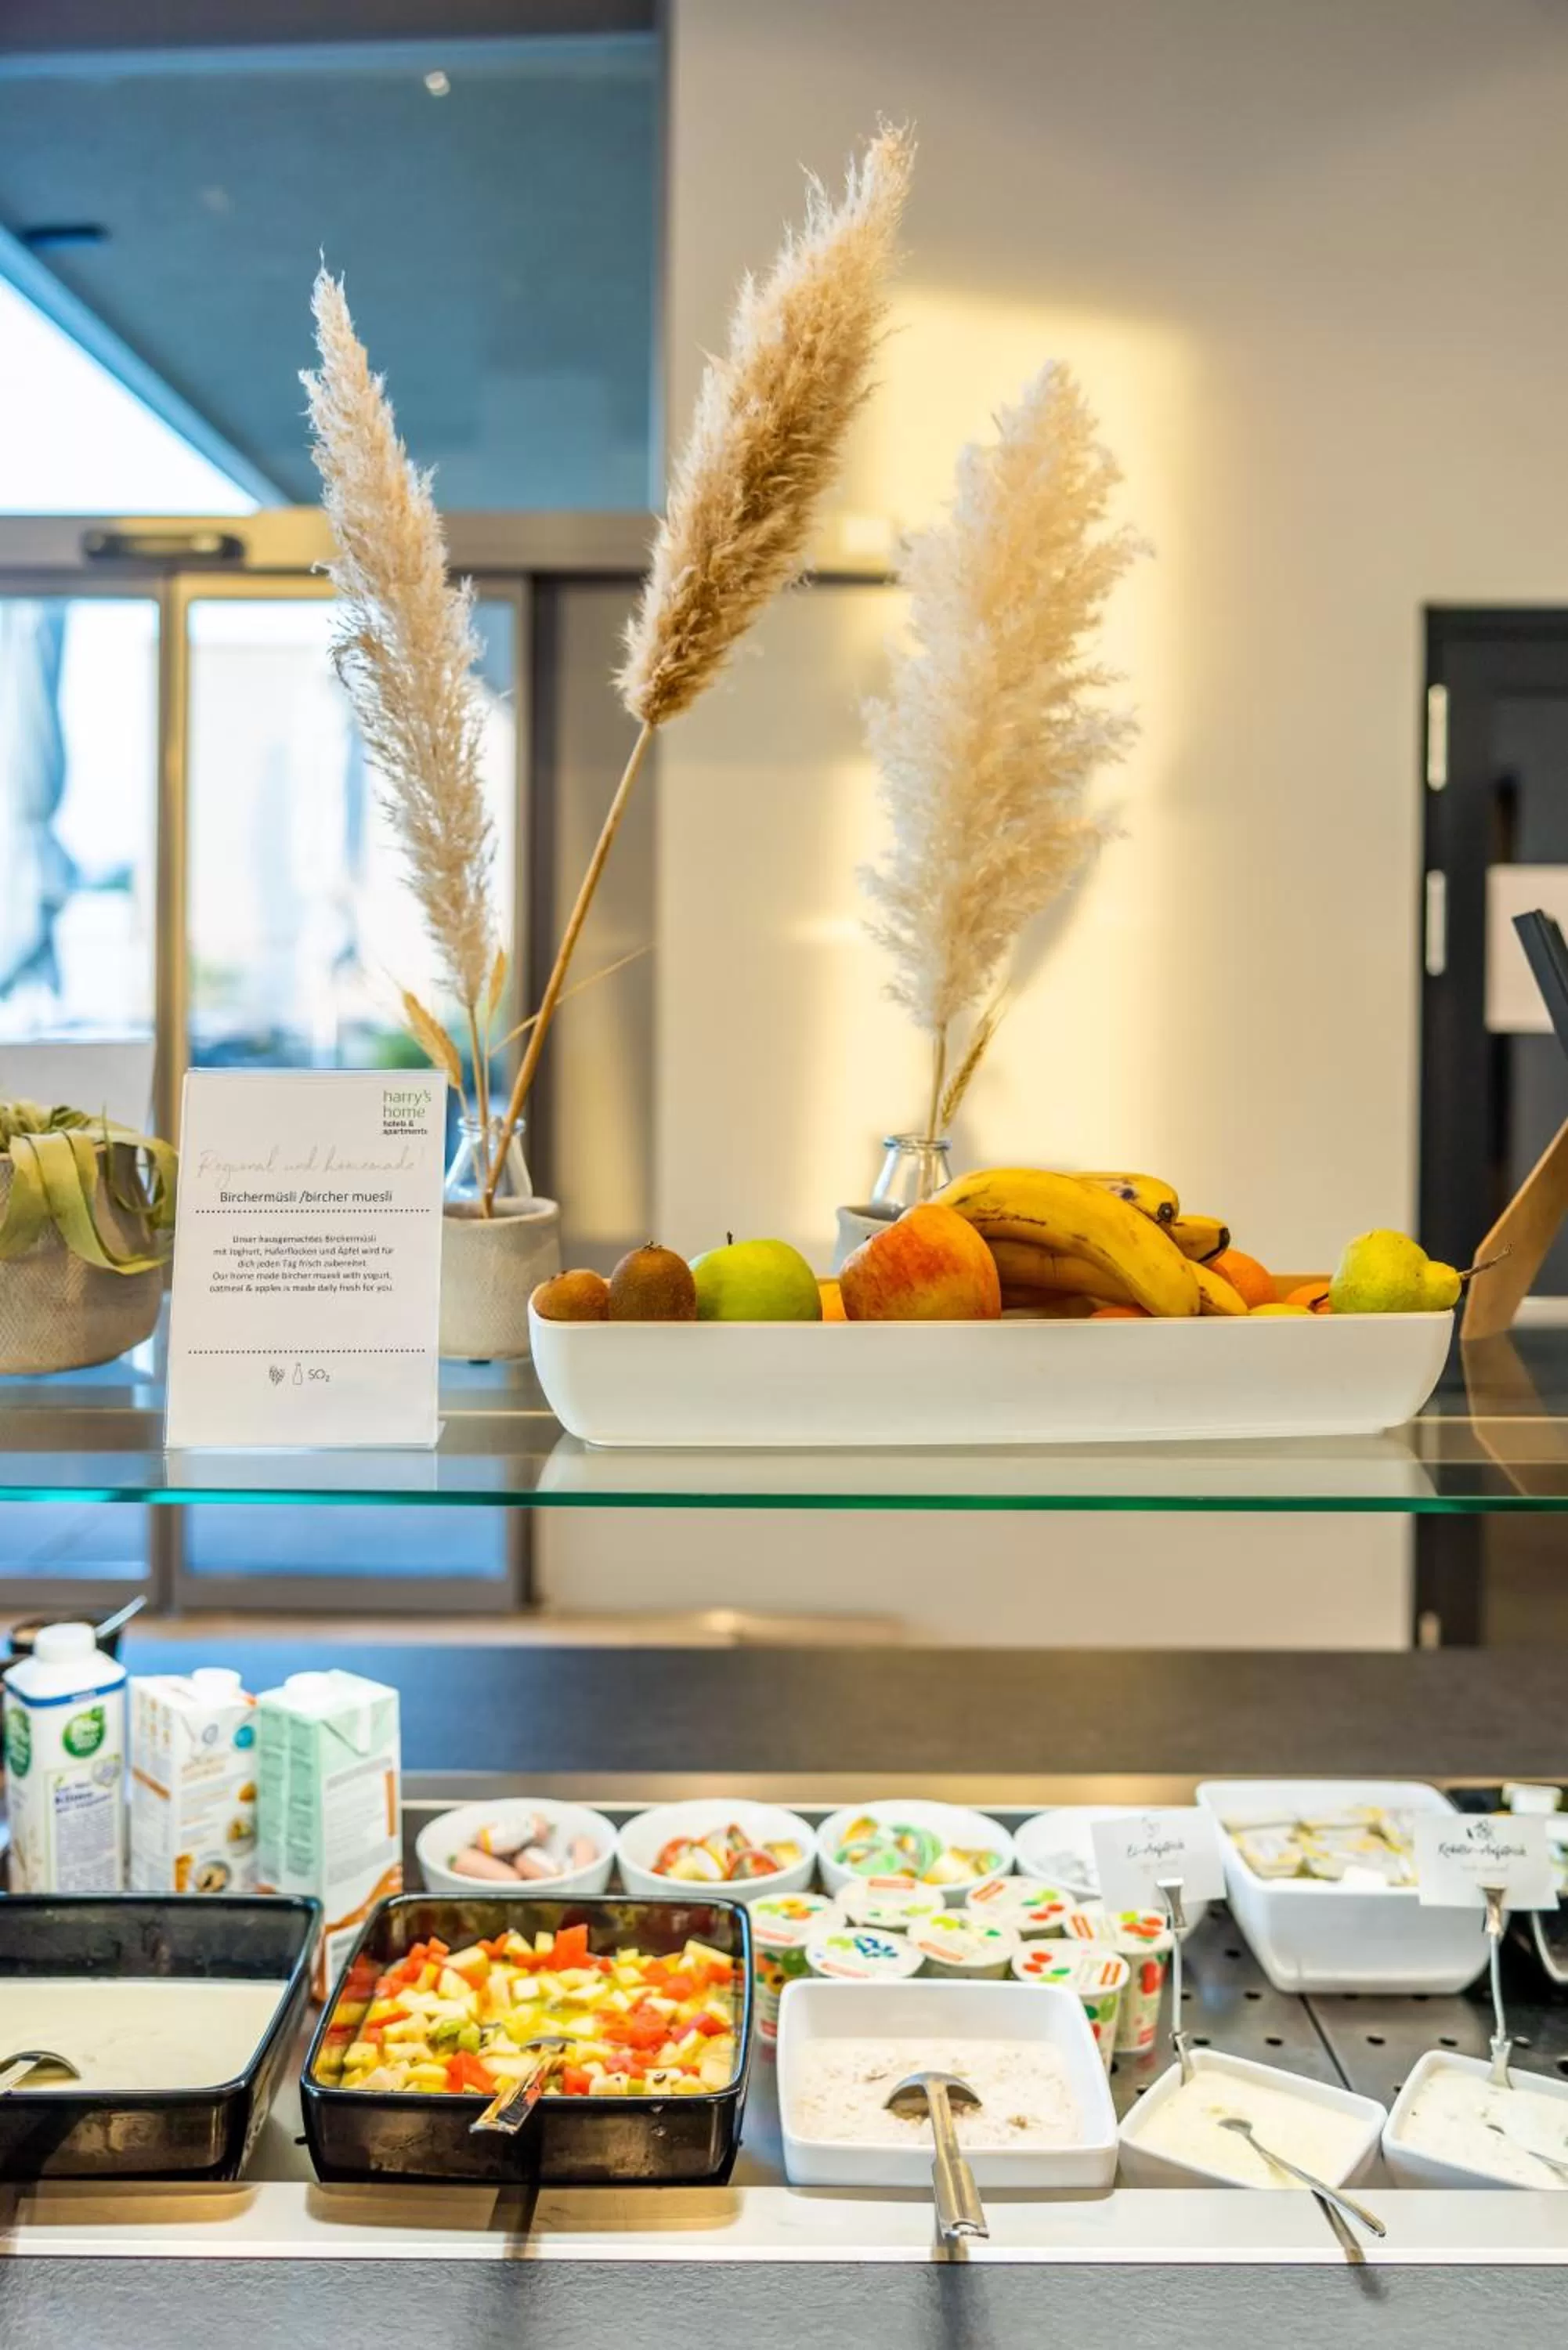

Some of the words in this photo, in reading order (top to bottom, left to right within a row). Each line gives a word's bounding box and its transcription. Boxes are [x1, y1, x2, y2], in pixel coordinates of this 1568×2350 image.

[383, 1089, 432, 1106] harry's
[383, 1104, 425, 1118] home
[284, 1144, 319, 1172] und
[219, 1190, 297, 1203] Birchermüsli
[351, 1190, 393, 1202] muesli
[233, 1235, 256, 1244] Unser
[258, 1235, 322, 1246] hausgemachtes
[325, 1235, 377, 1243] Birchermüsli
[265, 1246, 317, 1255] Haferflocken
[237, 1259, 255, 1267] dich
[256, 1260, 280, 1269] jeden
[282, 1259, 297, 1269] Tag
[212, 1271, 228, 1281] Our
[230, 1271, 255, 1280] home
[256, 1271, 280, 1280] made
[209, 1284, 244, 1292] oatmeal
[255, 1284, 281, 1294] apples
[317, 1284, 337, 1294] daily
[338, 1283, 360, 1292] fresh
[362, 1283, 374, 1292] for
